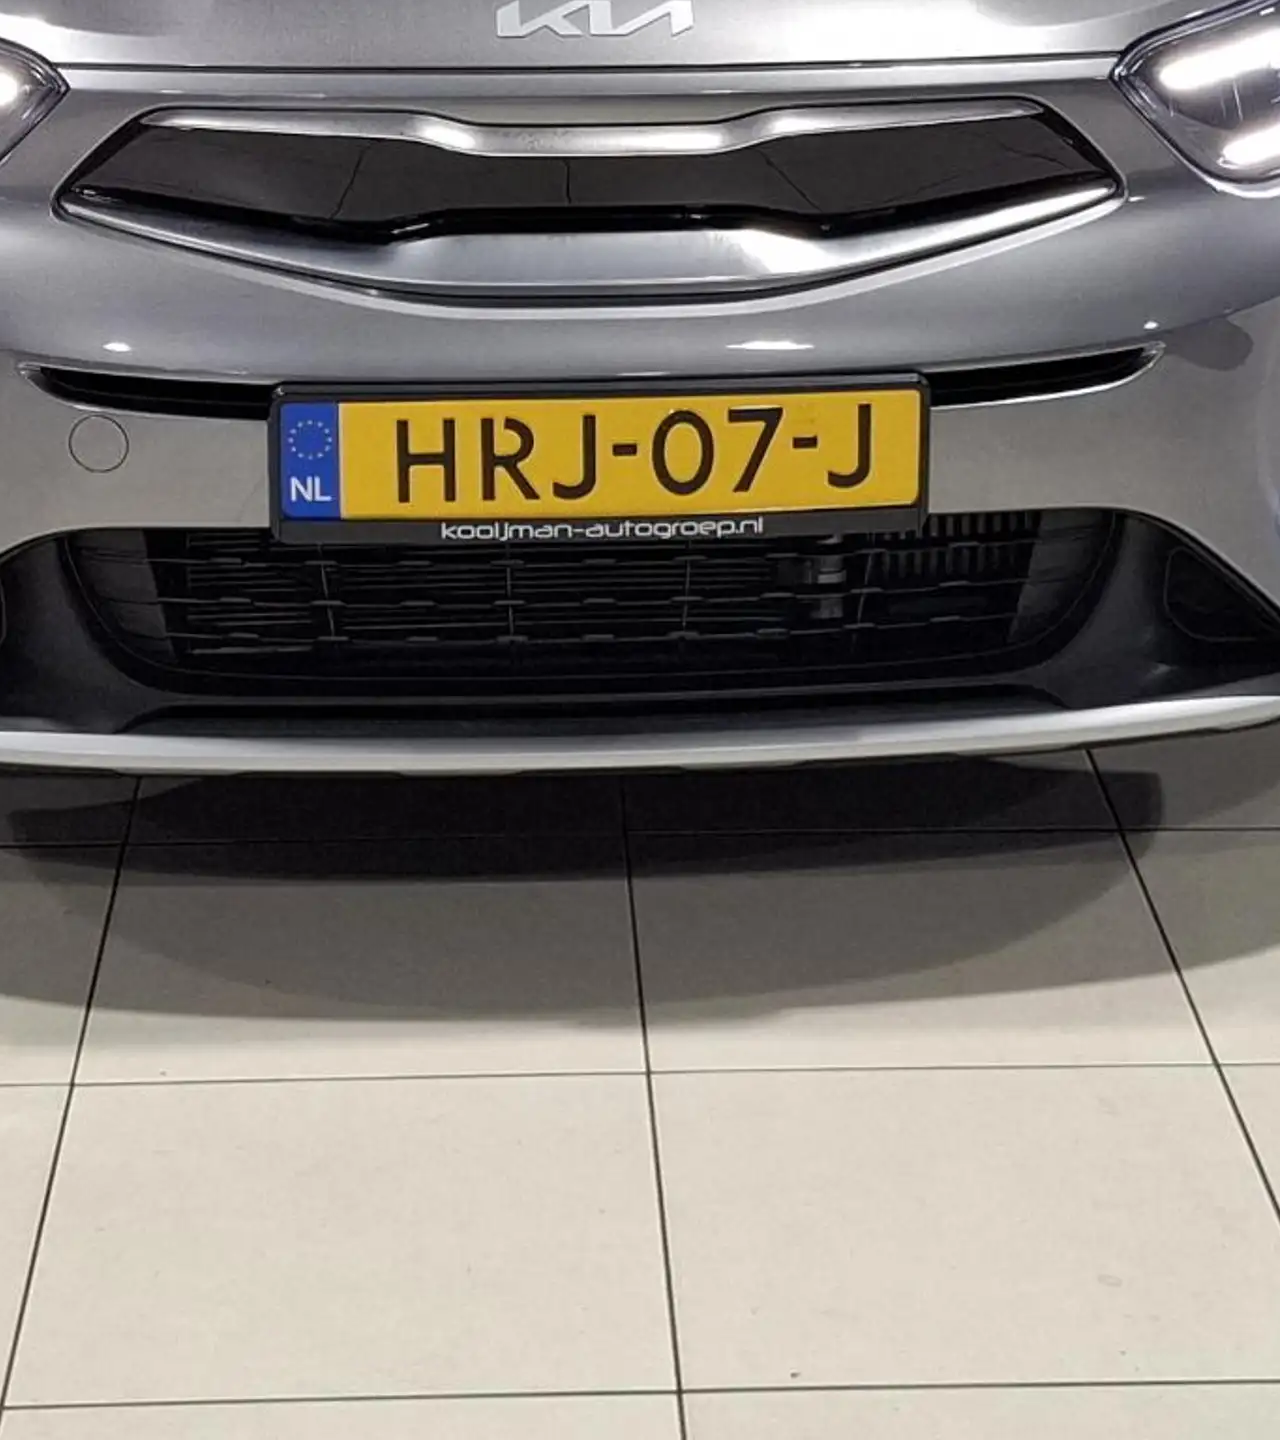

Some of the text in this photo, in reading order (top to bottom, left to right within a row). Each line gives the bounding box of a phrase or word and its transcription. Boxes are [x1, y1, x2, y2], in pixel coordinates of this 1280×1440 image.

[396, 404, 872, 503] HRJ-07-J
[290, 476, 332, 502] NL
[441, 517, 764, 541] kooijman-autogroep.nl
